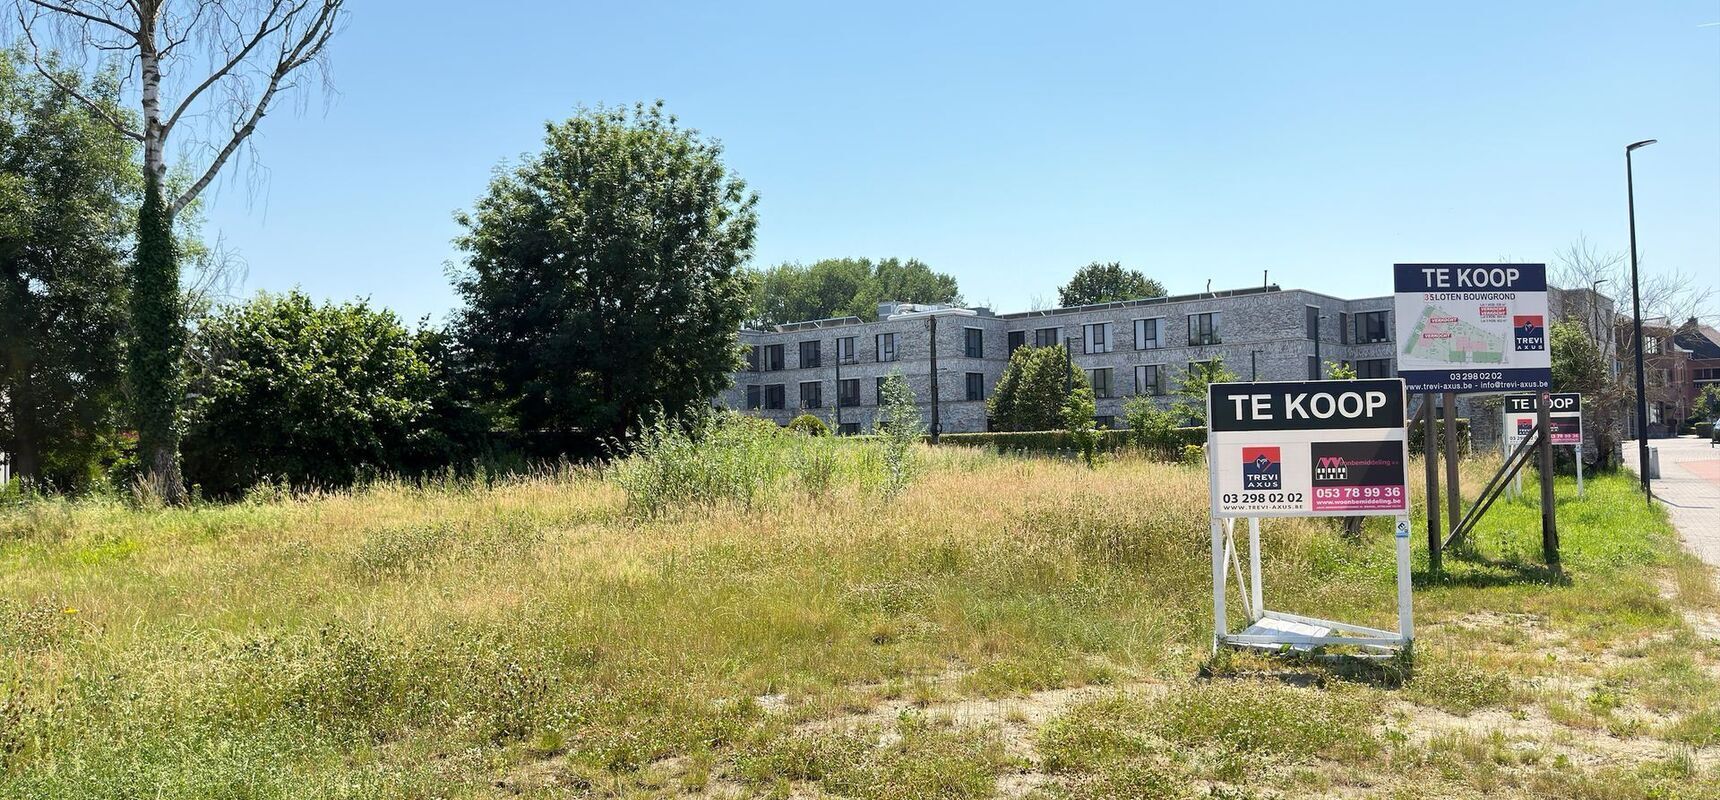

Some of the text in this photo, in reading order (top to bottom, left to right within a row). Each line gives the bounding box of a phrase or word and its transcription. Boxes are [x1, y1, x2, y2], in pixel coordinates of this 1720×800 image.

[1422, 268, 1519, 287] TE KOOP
[1480, 372, 1490, 380] 02
[1228, 391, 1387, 421] TE KOOP
[1512, 398, 1573, 409] TE OP
[1223, 493, 1303, 503] 03 298 02 02
[1316, 487, 1401, 498] 053 78 99 36
